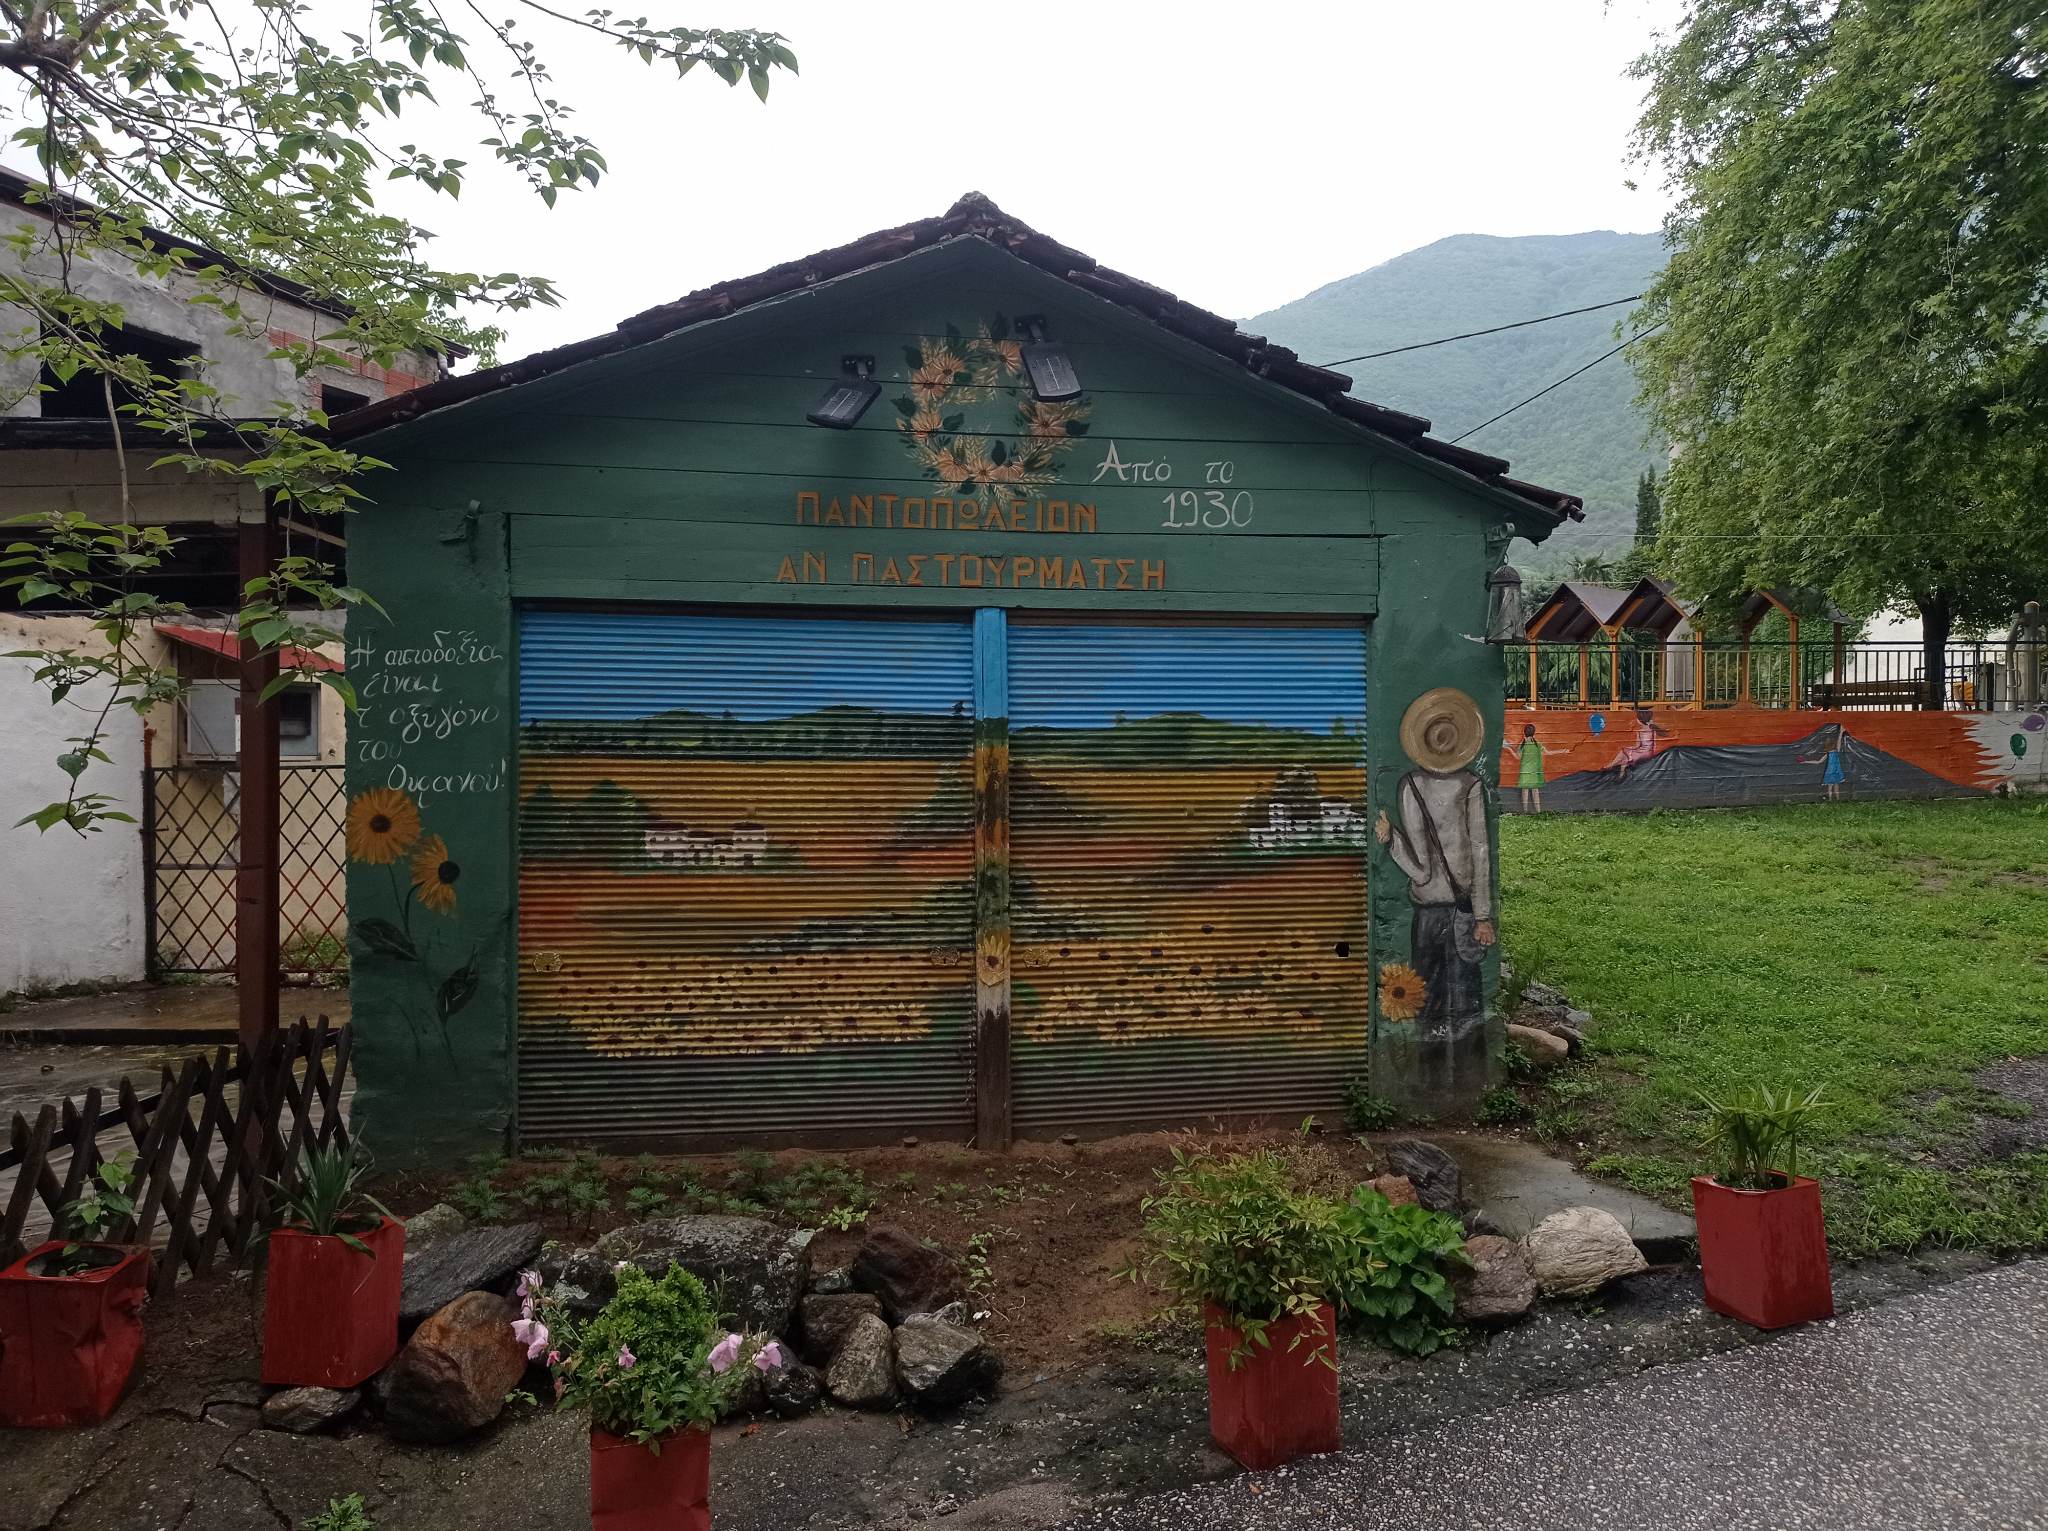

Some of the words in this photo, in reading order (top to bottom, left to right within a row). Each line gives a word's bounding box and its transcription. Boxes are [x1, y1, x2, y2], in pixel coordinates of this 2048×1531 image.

[1091, 439, 1172, 484] Από
[1205, 461, 1234, 484] το
[797, 490, 1097, 533] ΠΑΝΤΟΠΩΛΕΙΟΝ
[1161, 490, 1254, 528] 1930
[776, 551, 827, 584] ΑΝ
[852, 551, 1165, 590] ΠΑΣΤΟΥΡΜΑΤΣΗ
[351, 636, 376, 670] Η
[363, 669, 443, 697] είναι
[389, 699, 499, 744] οξυγόνο
[358, 740, 402, 762] του
